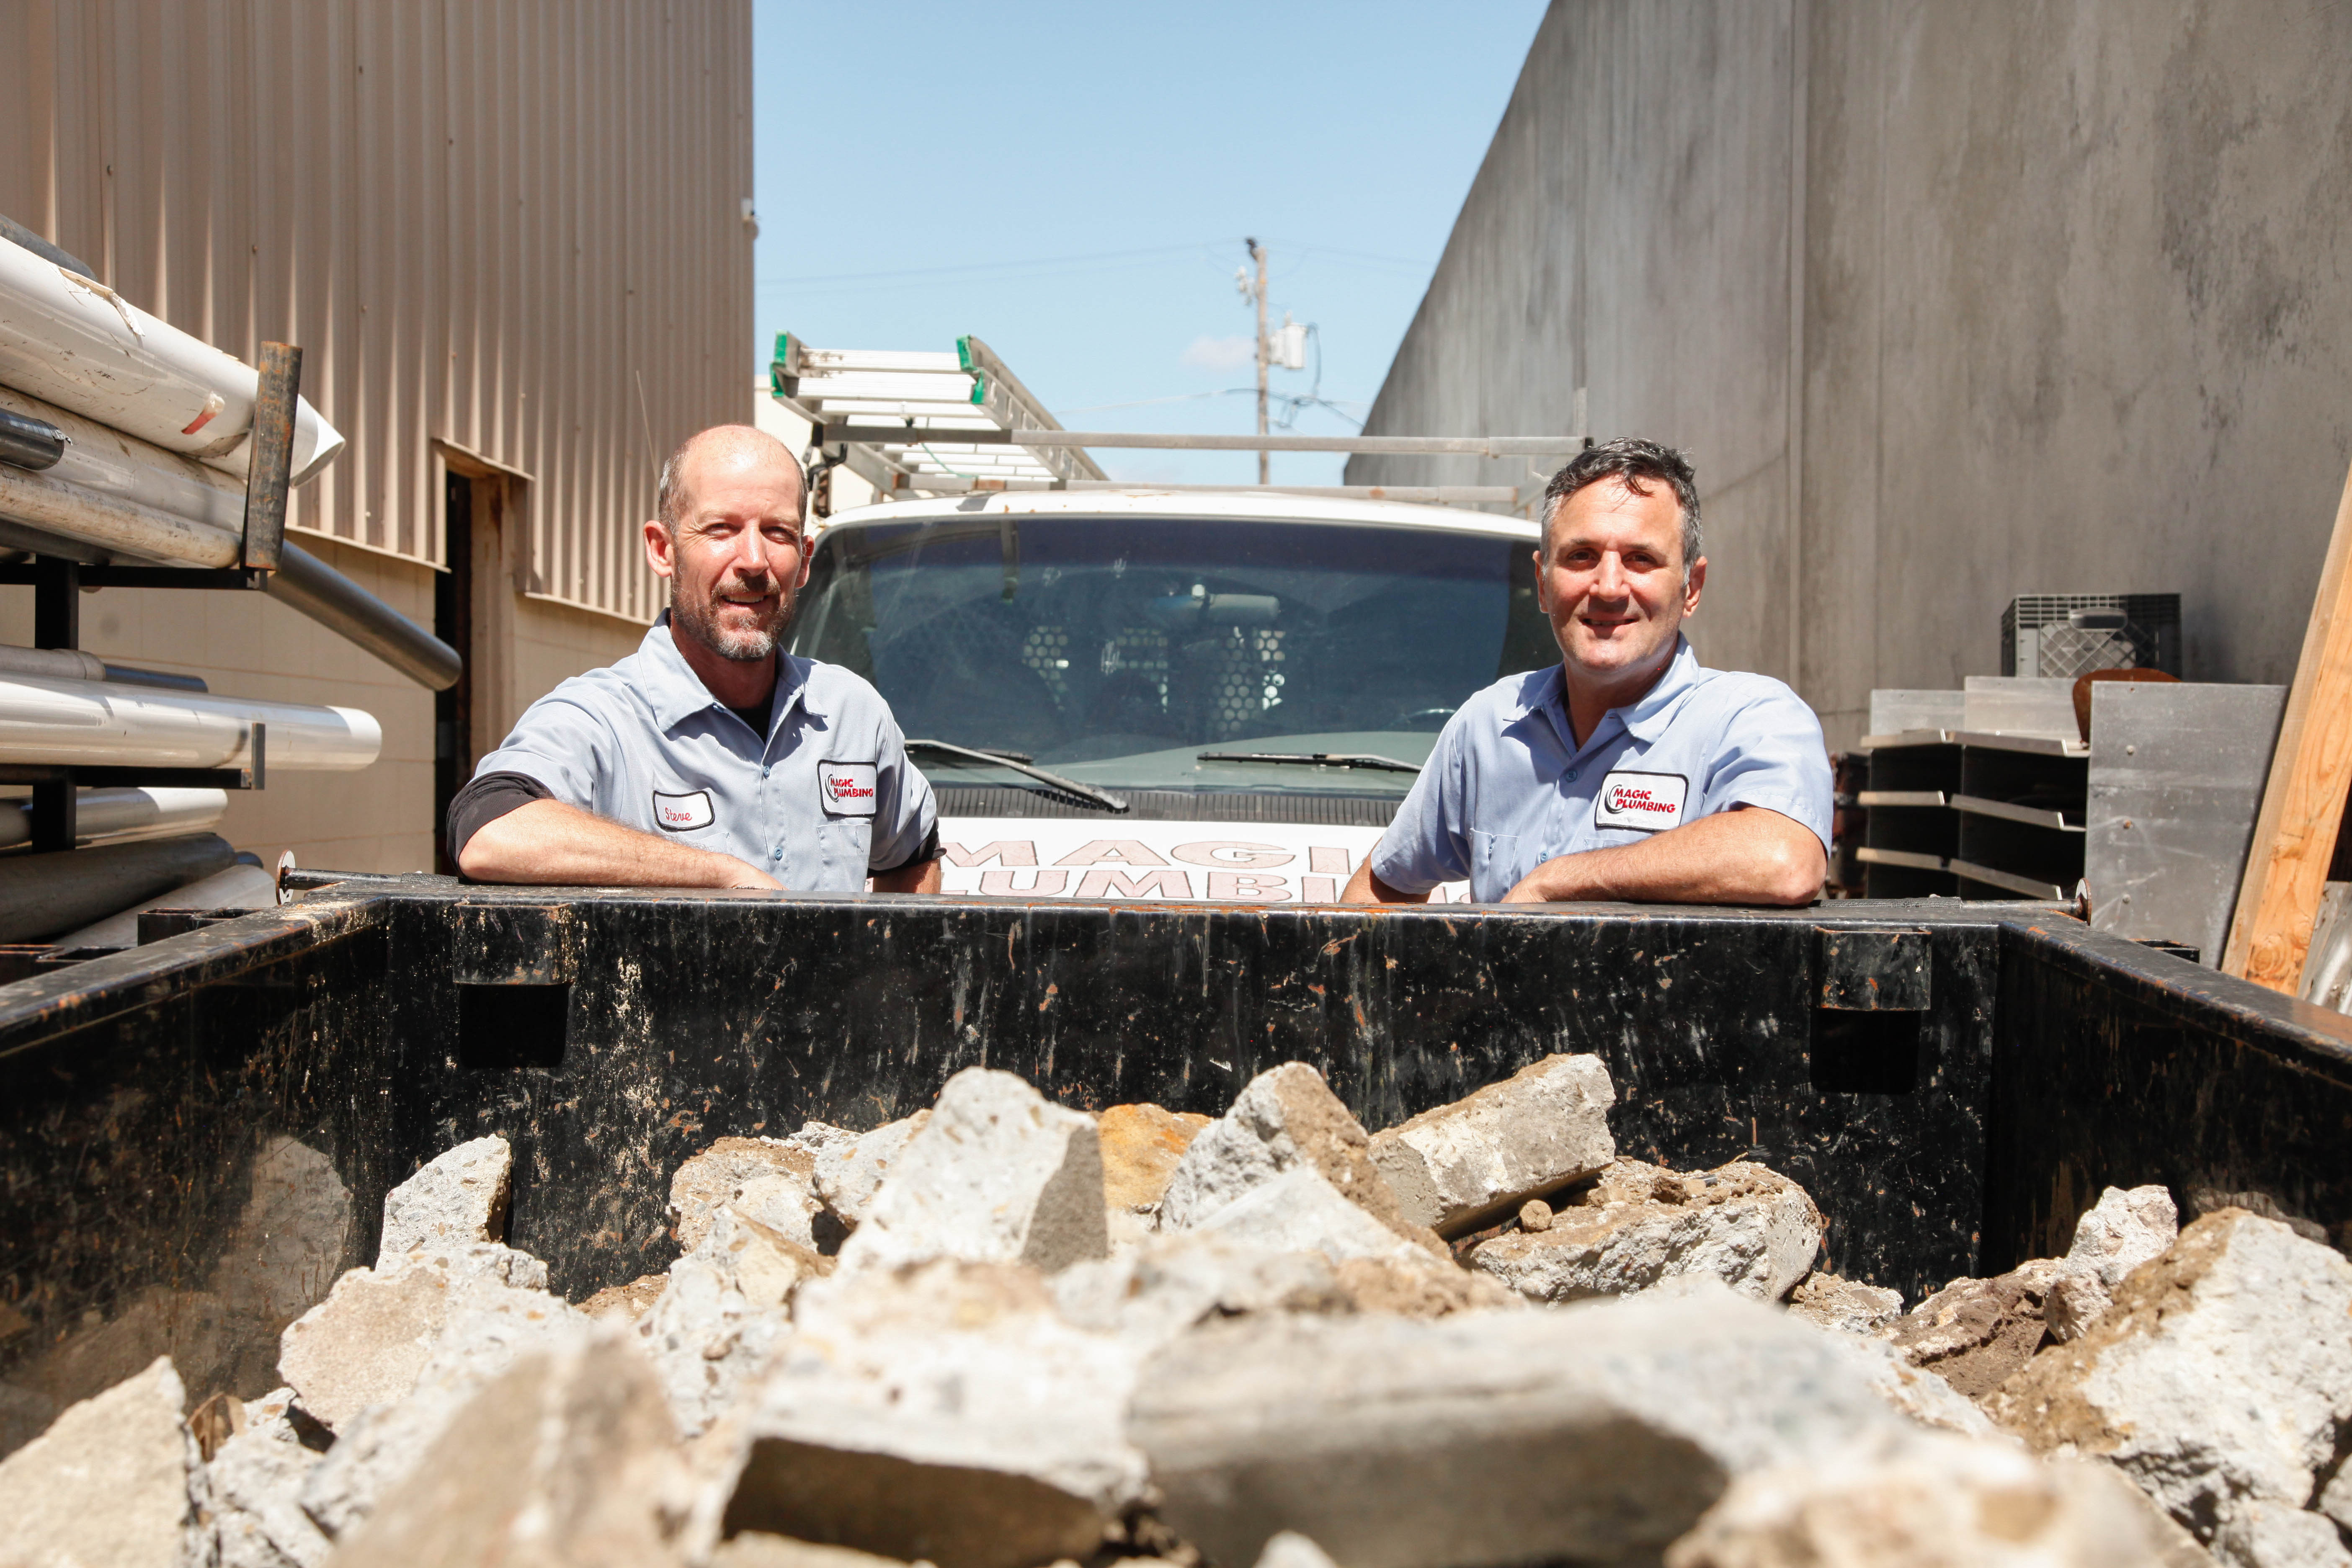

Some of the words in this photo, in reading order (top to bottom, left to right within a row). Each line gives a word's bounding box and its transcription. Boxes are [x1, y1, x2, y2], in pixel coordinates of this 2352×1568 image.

[830, 777, 853, 787] MAGIC
[834, 787, 873, 797] PLUMBING
[1613, 788, 1652, 800] MAGIC
[1615, 798, 1676, 813] PLUMBING
[665, 807, 692, 821] Steve
[941, 840, 1350, 874] MAGI
